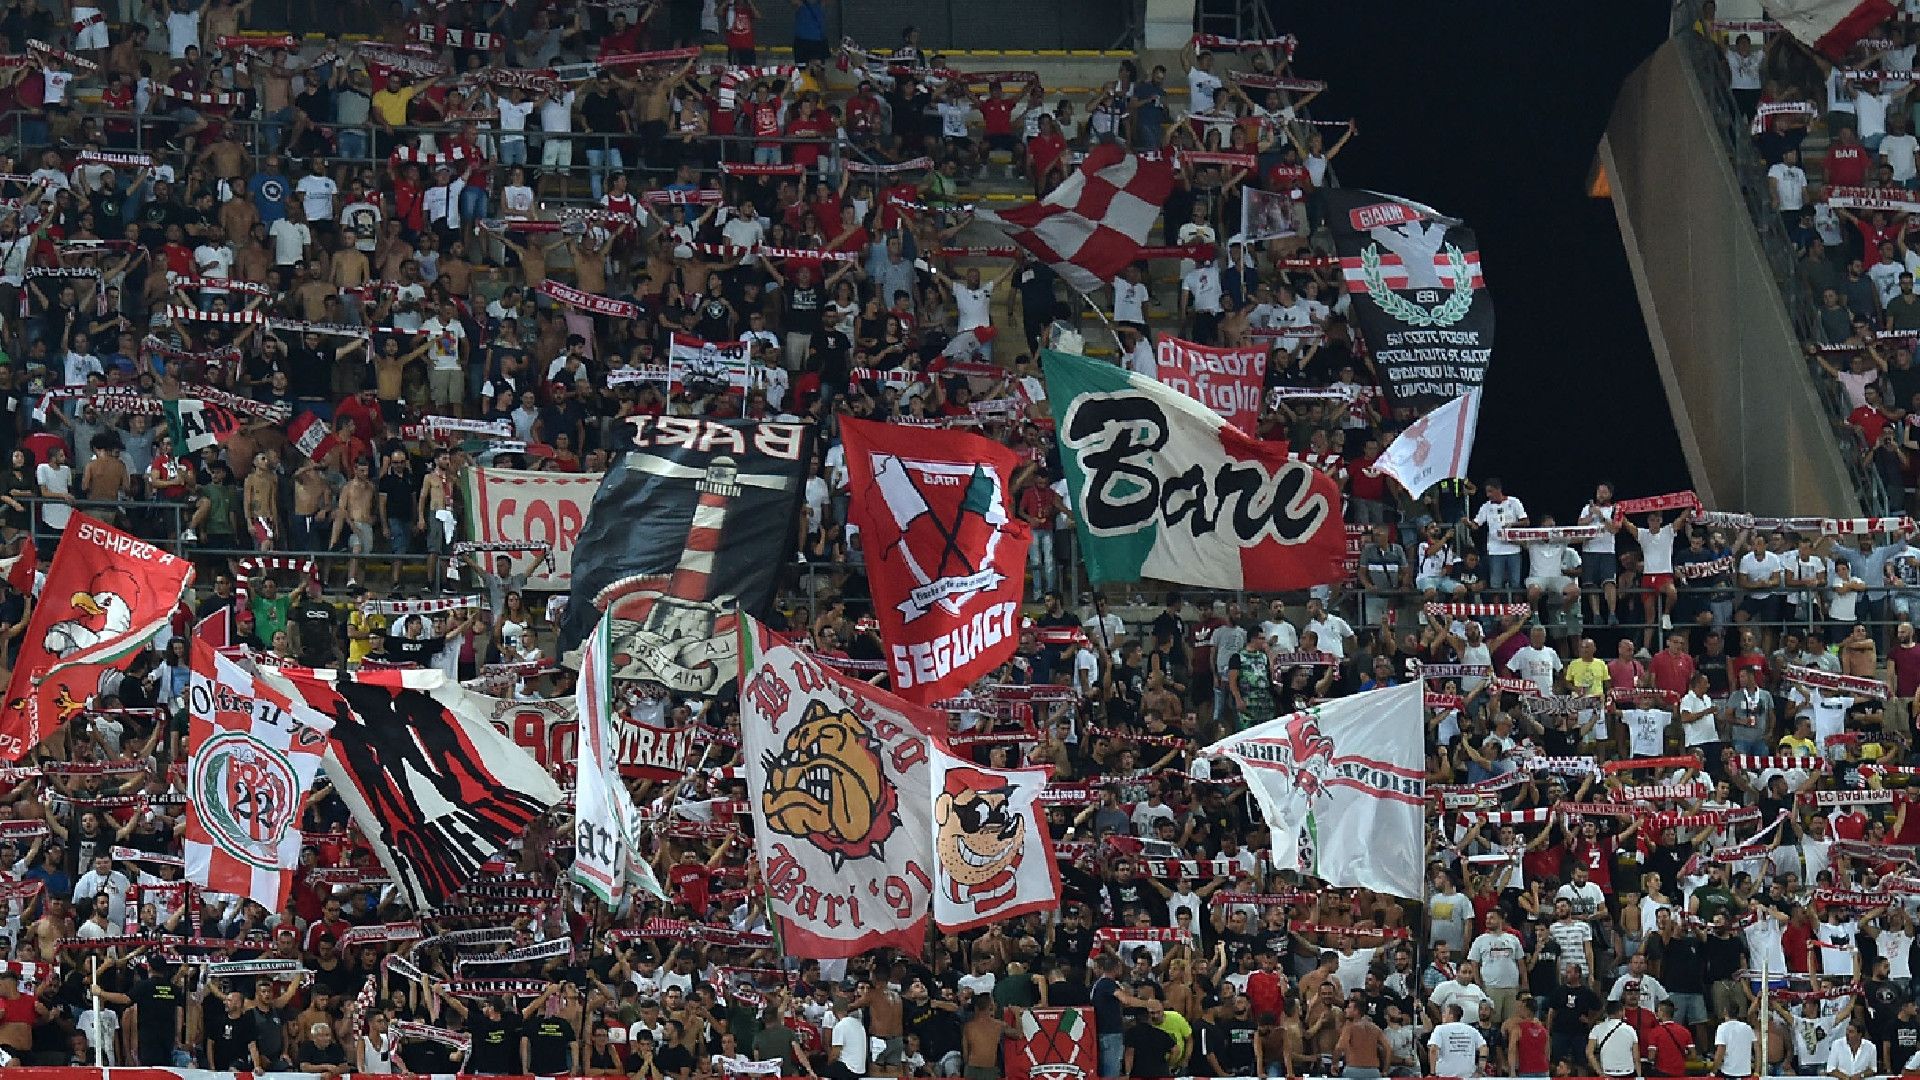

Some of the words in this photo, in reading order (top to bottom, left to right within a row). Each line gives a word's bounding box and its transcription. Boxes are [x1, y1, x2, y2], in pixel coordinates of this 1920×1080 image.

[1158, 341, 1182, 369] di
[1189, 352, 1267, 376] padre
[1196, 374, 1259, 417] figlio
[181, 407, 235, 439] ARI
[1061, 389, 1329, 548] Bari
[78, 522, 159, 561] SEMPRE
[892, 602, 1018, 689] SEGUACI
[1588, 852, 1601, 869] 7
[766, 842, 865, 930] Bari
